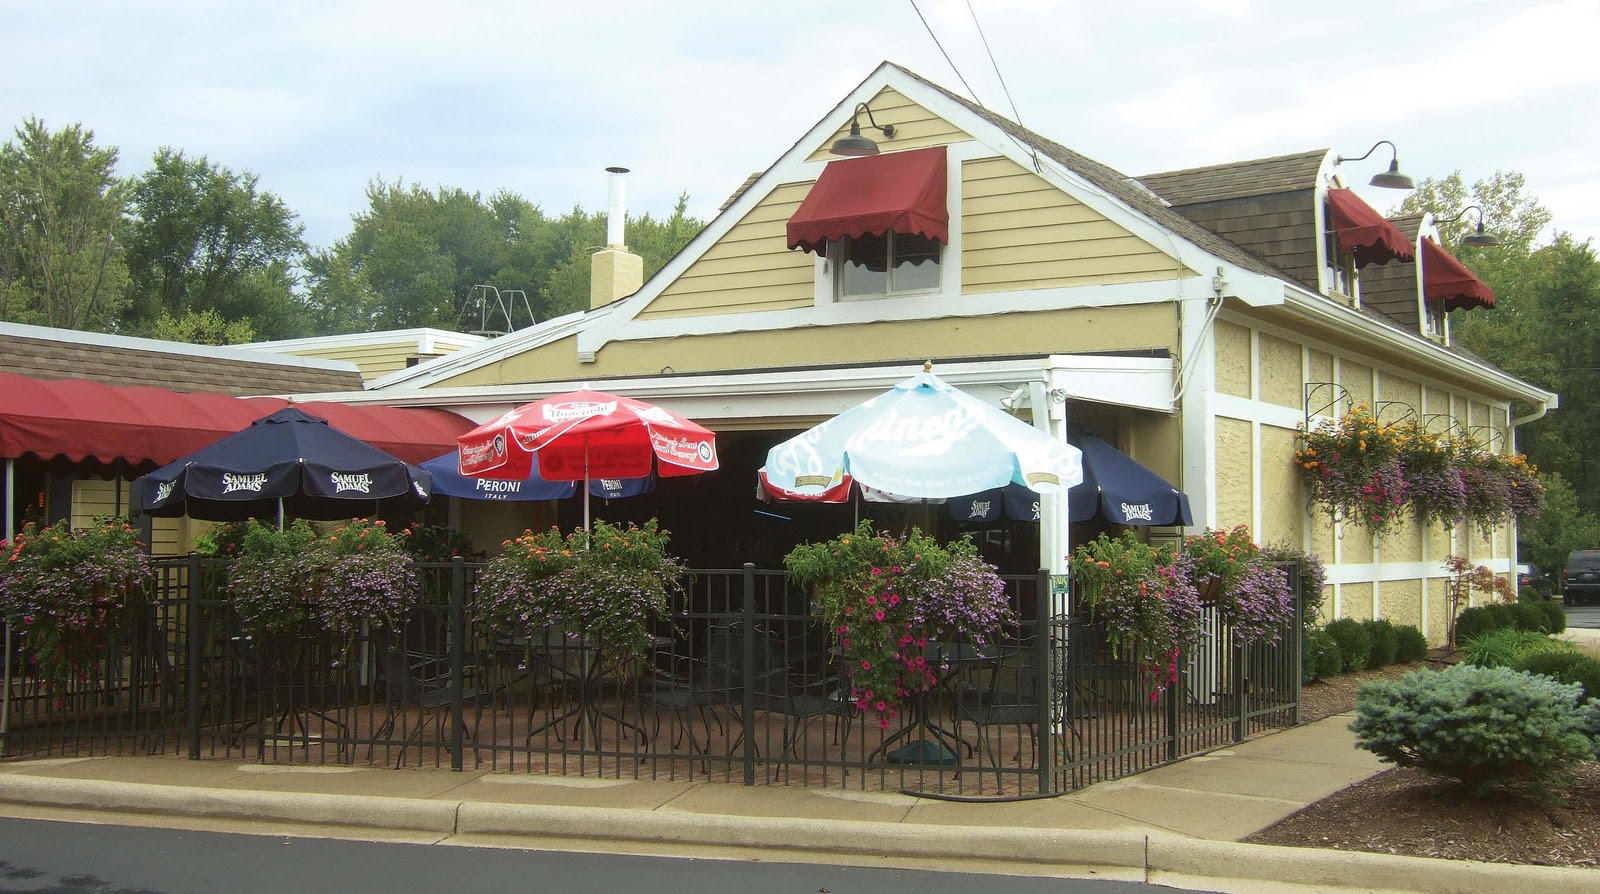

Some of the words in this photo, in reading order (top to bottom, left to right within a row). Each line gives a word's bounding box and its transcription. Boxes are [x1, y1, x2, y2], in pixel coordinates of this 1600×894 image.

[222, 472, 268, 485] SAMUEL
[331, 471, 373, 485] SAMUEL
[601, 478, 623, 491] PERONI
[222, 481, 263, 494] ADAMS
[336, 482, 370, 494] ADAMS
[476, 478, 521, 493] PERONI
[1121, 502, 1153, 513] SAMUEL
[1126, 511, 1152, 521] ADAMS
